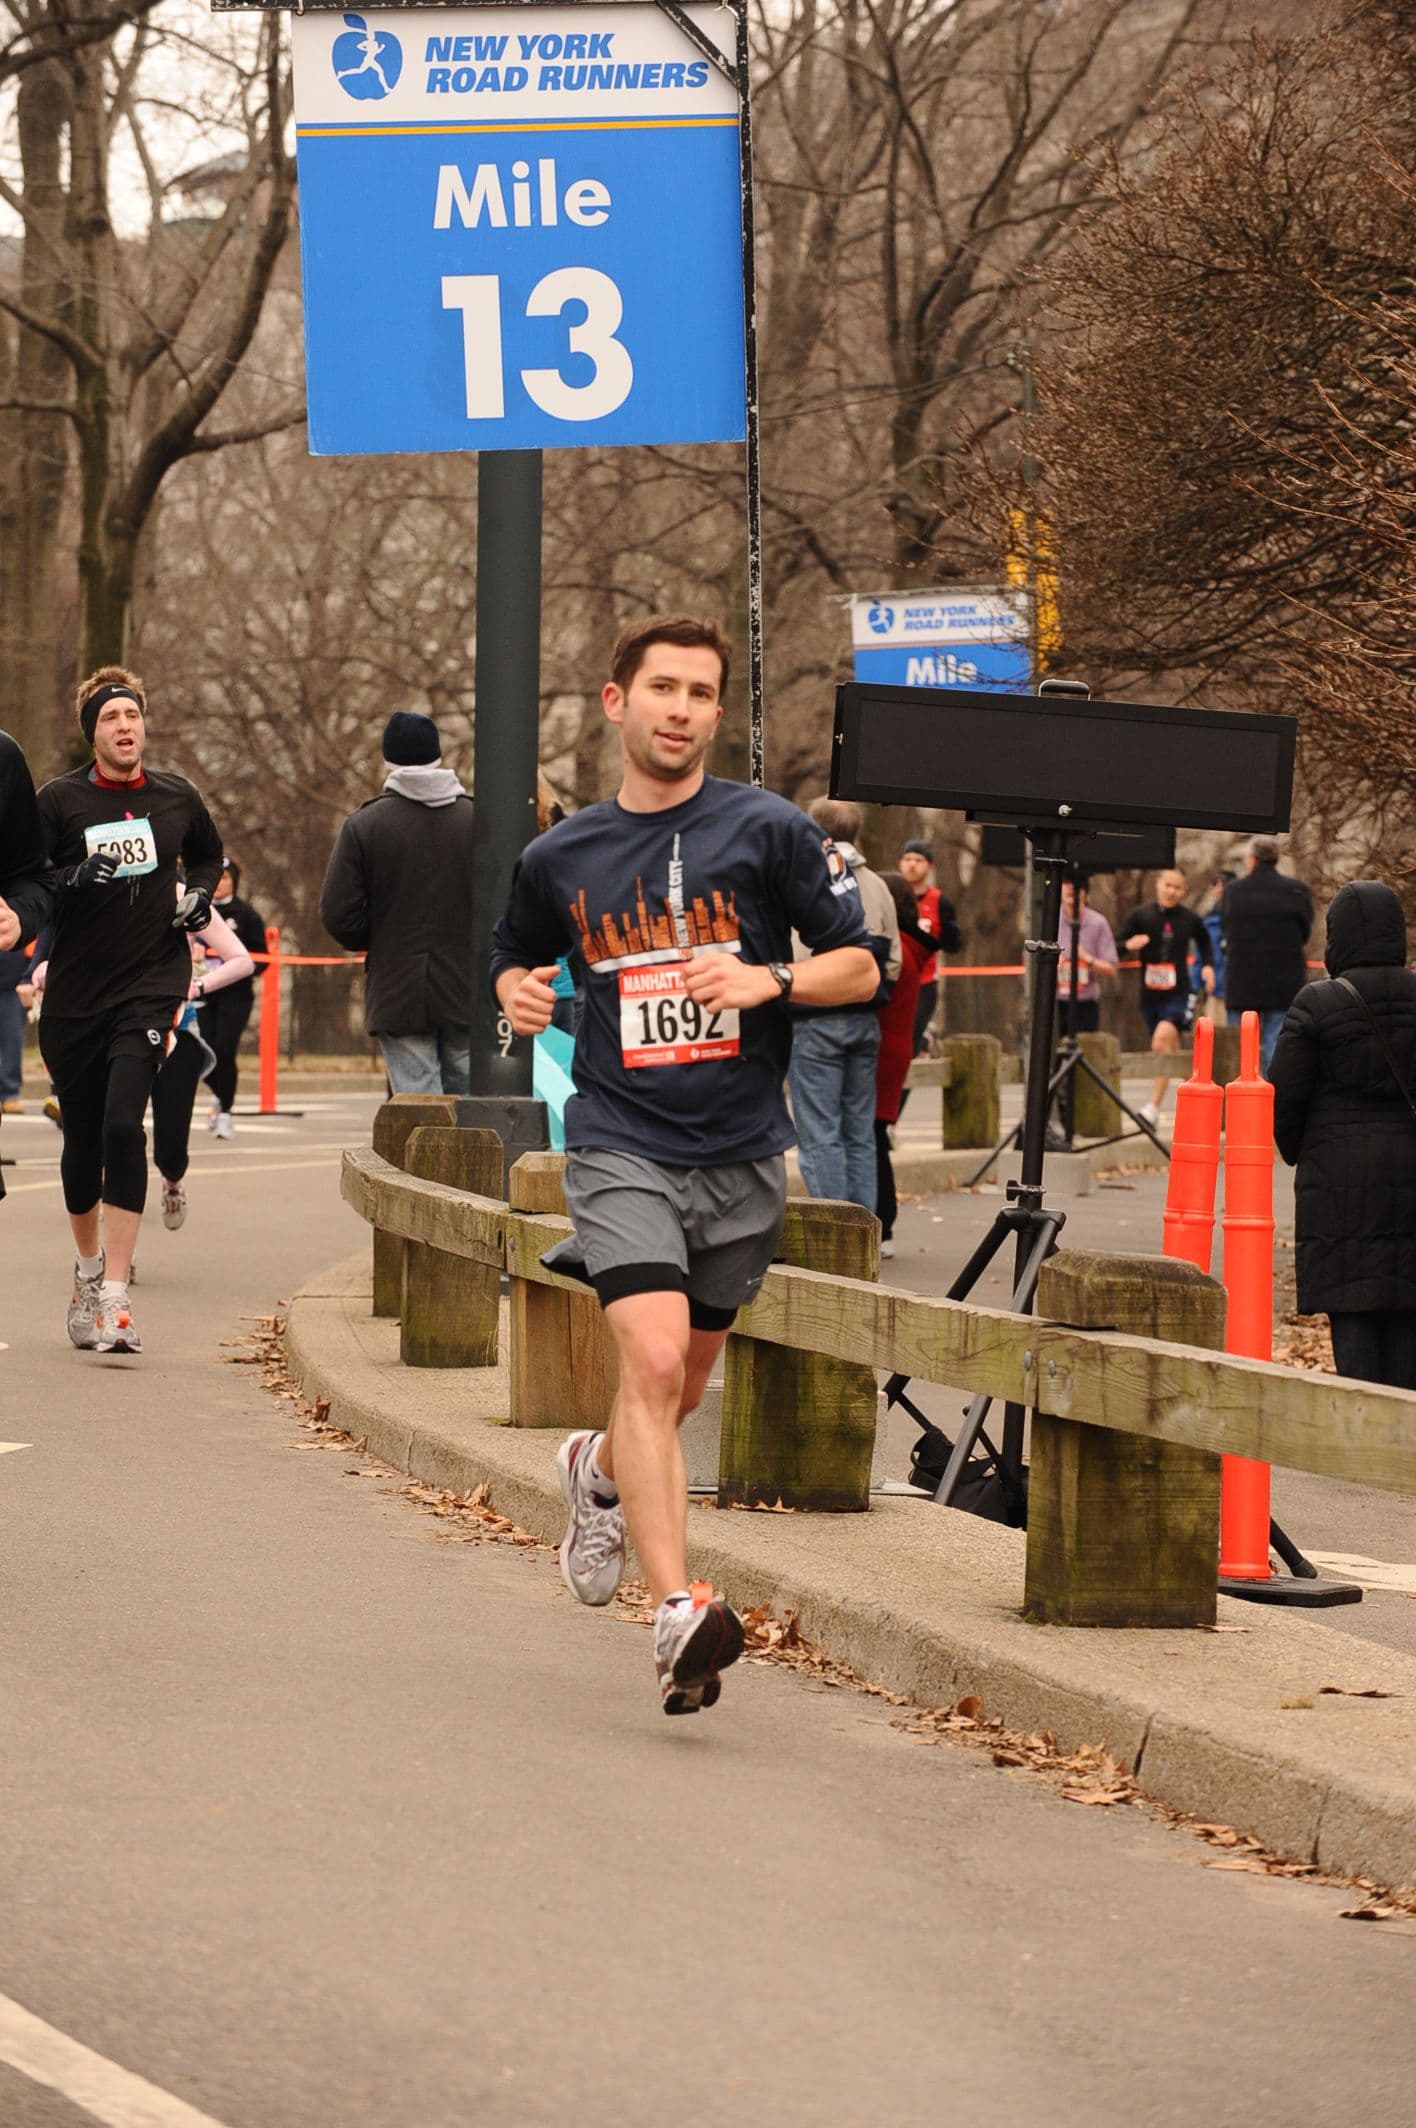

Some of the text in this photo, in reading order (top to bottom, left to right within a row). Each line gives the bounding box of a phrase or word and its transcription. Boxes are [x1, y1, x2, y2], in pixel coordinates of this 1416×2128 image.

[425, 33, 615, 63] NEW YORK
[425, 61, 709, 94] ROAD RUNNERS
[433, 158, 612, 230] Mile
[441, 266, 634, 422] 13
[903, 604, 978, 618] NEW YORK
[903, 614, 1016, 631] ROAD RUNNERS
[905, 654, 978, 685] Mile
[668, 860, 683, 888] CITY
[668, 887, 685, 917] YORK
[674, 917, 690, 948] NEW
[496, 1010, 513, 1058] 07
[638, 997, 723, 1045] 1692
